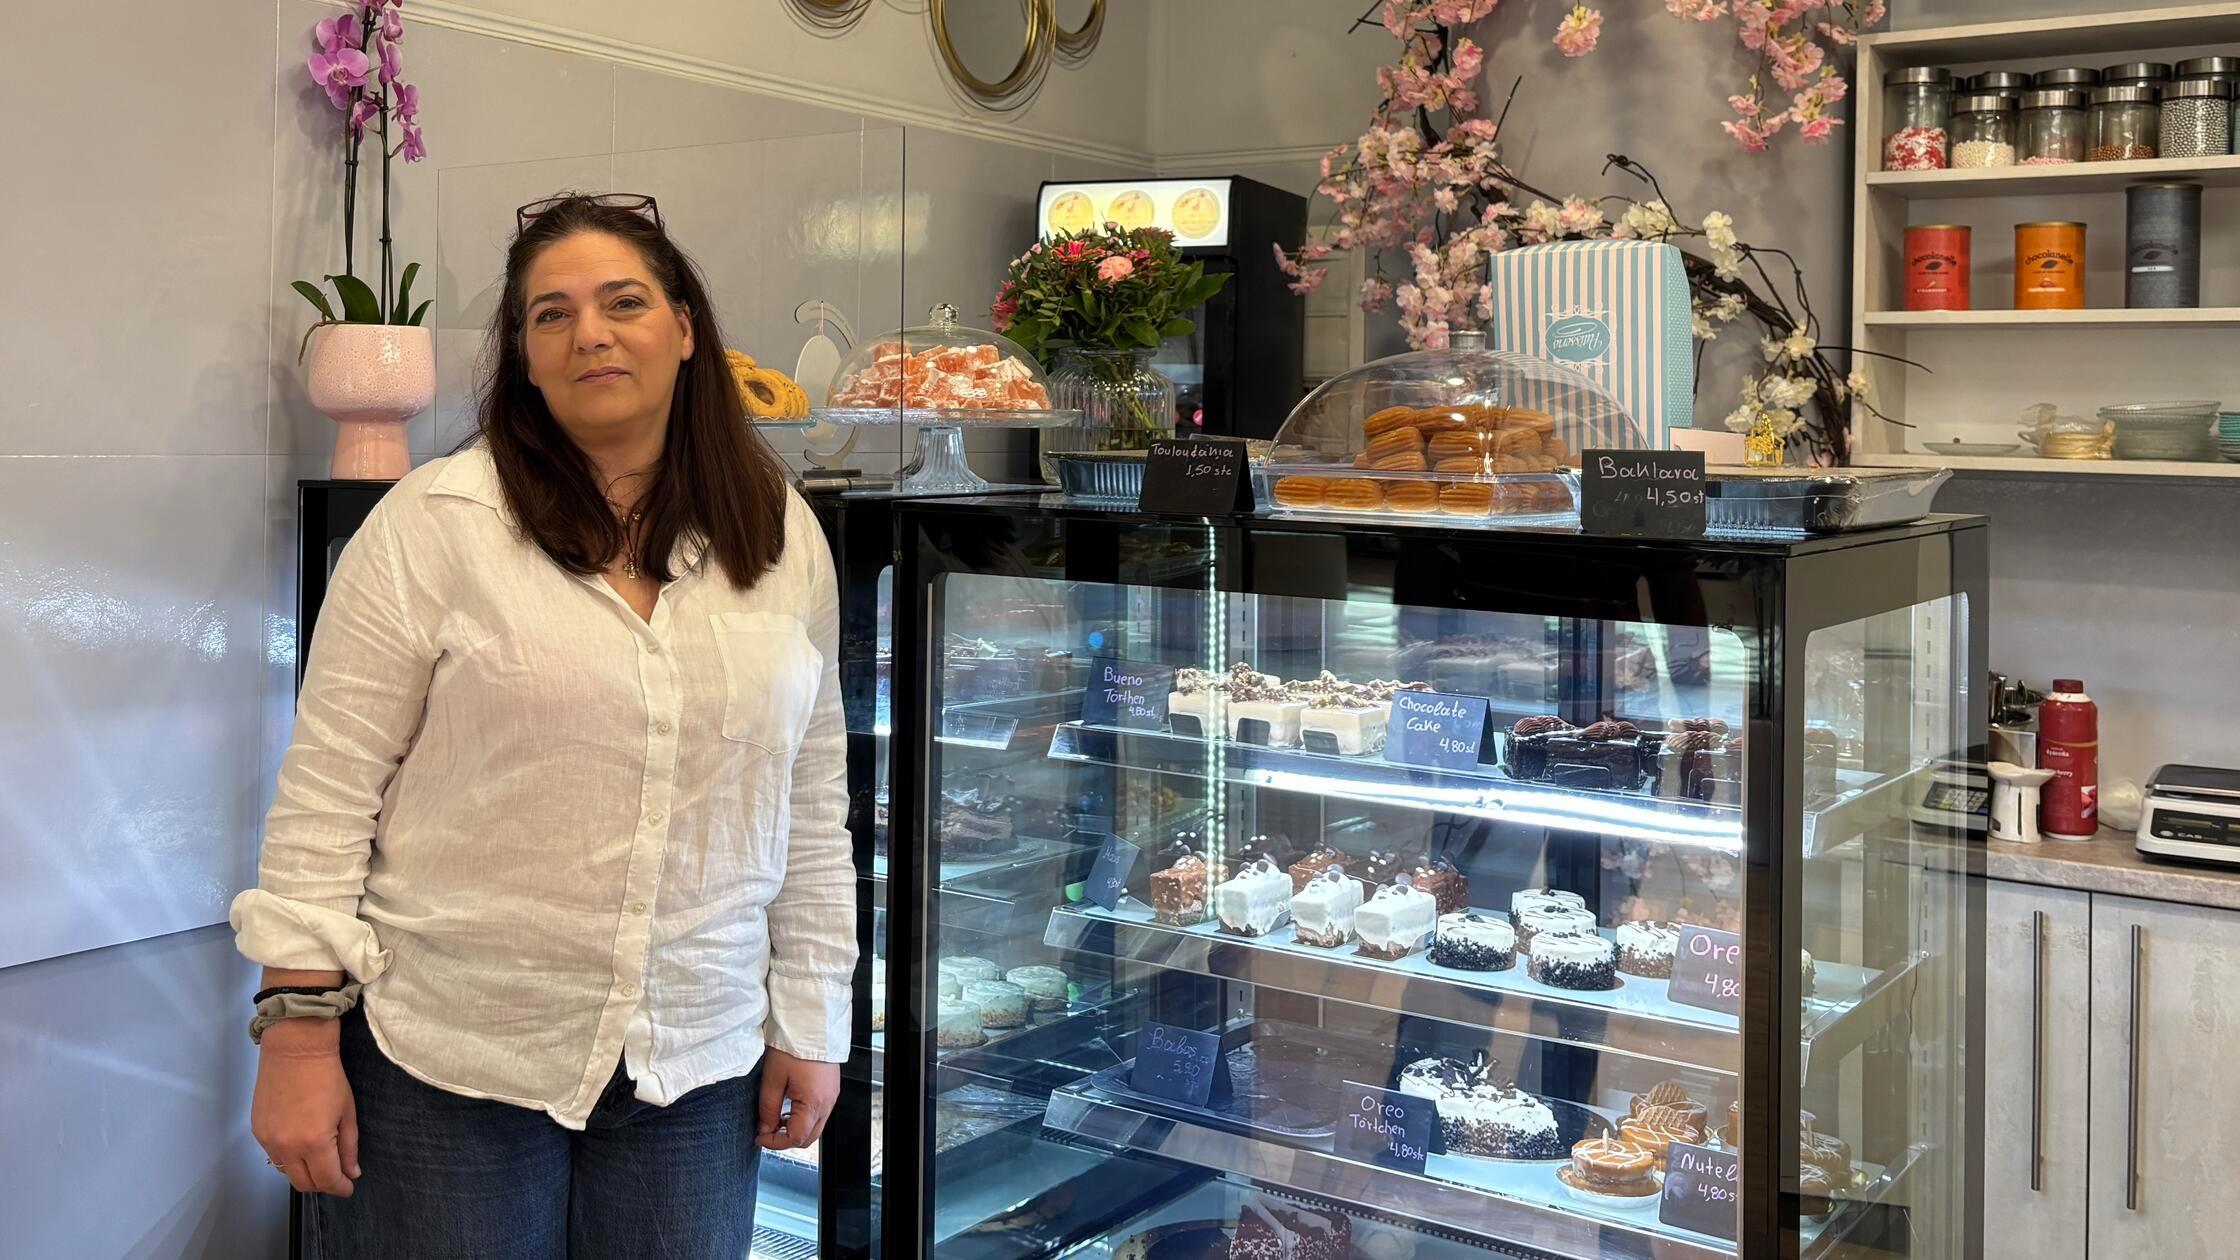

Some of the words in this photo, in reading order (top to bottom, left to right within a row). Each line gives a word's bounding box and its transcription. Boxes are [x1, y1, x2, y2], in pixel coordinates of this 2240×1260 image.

[1598, 455, 1700, 480] Baklava
[1103, 666, 1143, 686] Bueno
[1399, 696, 1467, 718] Chocolate
[1406, 716, 1441, 733] Cake
[1361, 1095, 1405, 1118] Oreo
